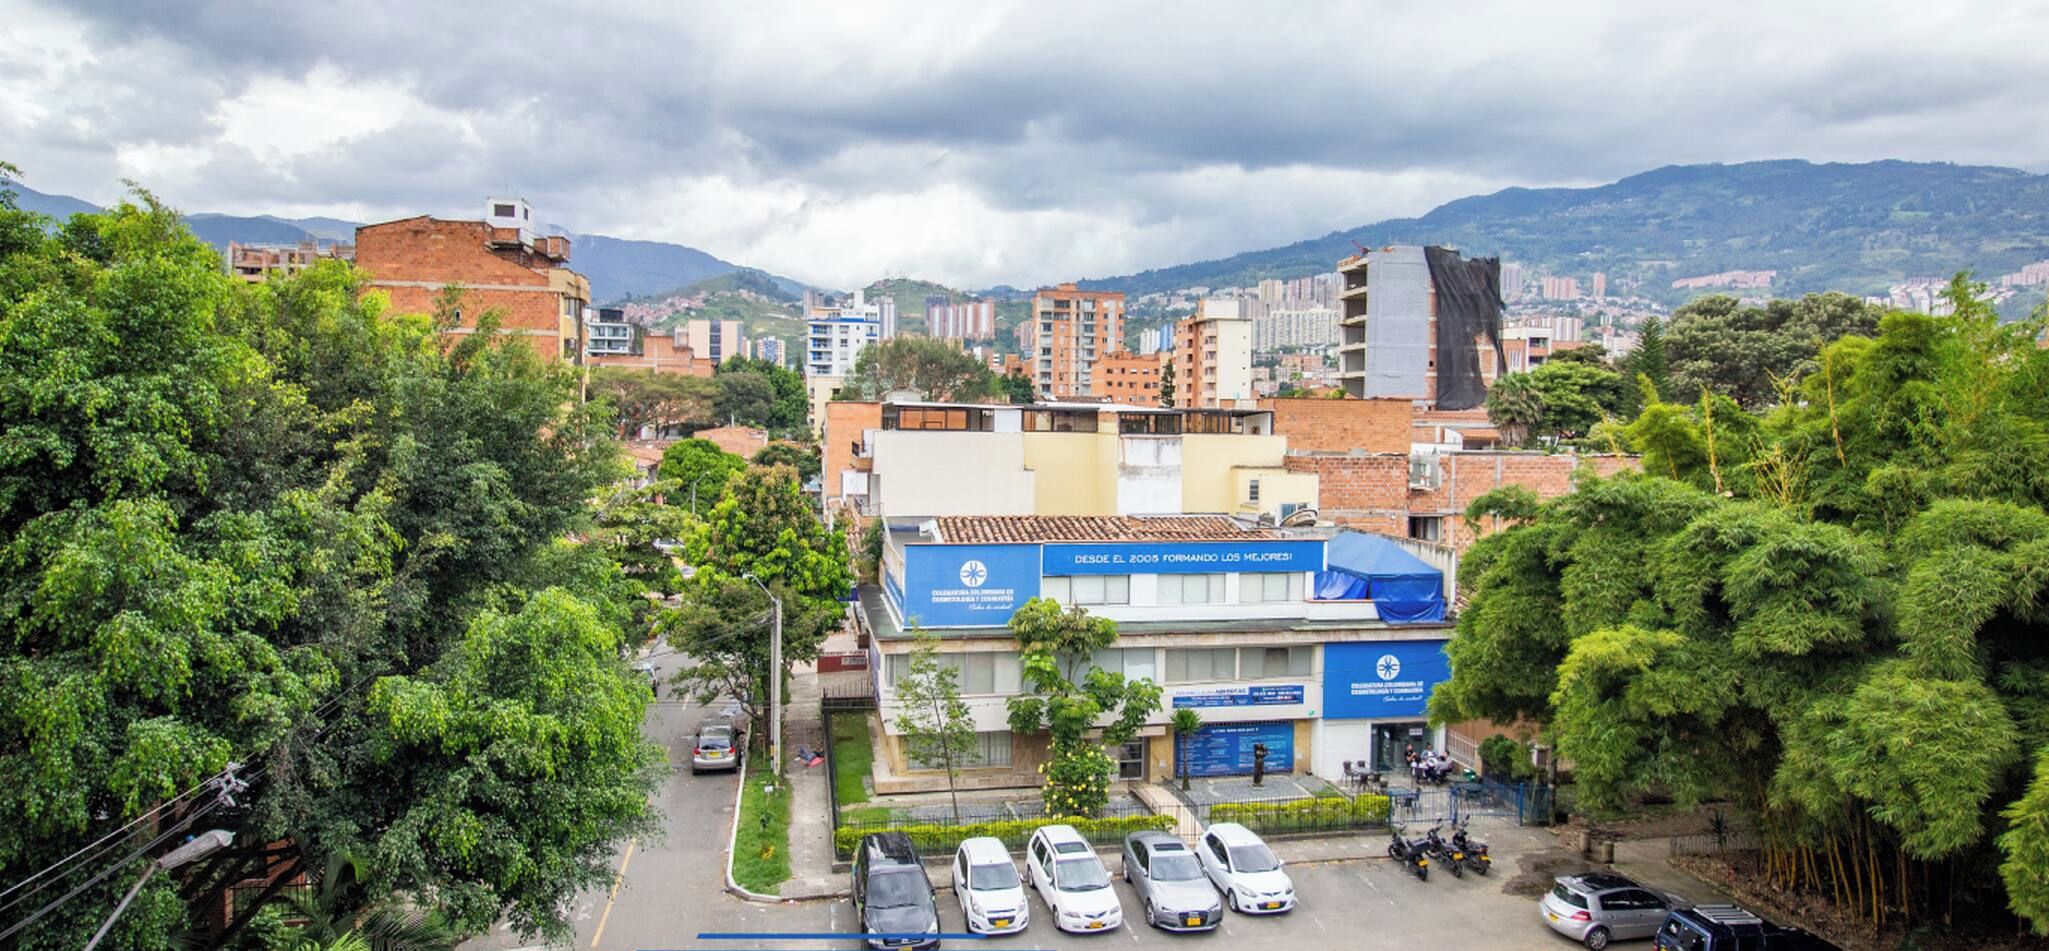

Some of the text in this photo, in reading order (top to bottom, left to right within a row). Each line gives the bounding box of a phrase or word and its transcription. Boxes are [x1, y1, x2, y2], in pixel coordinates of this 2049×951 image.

[1075, 554, 1110, 563] DESDE
[1112, 554, 1126, 563] EL
[1129, 553, 1159, 563] 2005
[1163, 553, 1218, 563] FORMANDO
[1221, 552, 1240, 562] LOS
